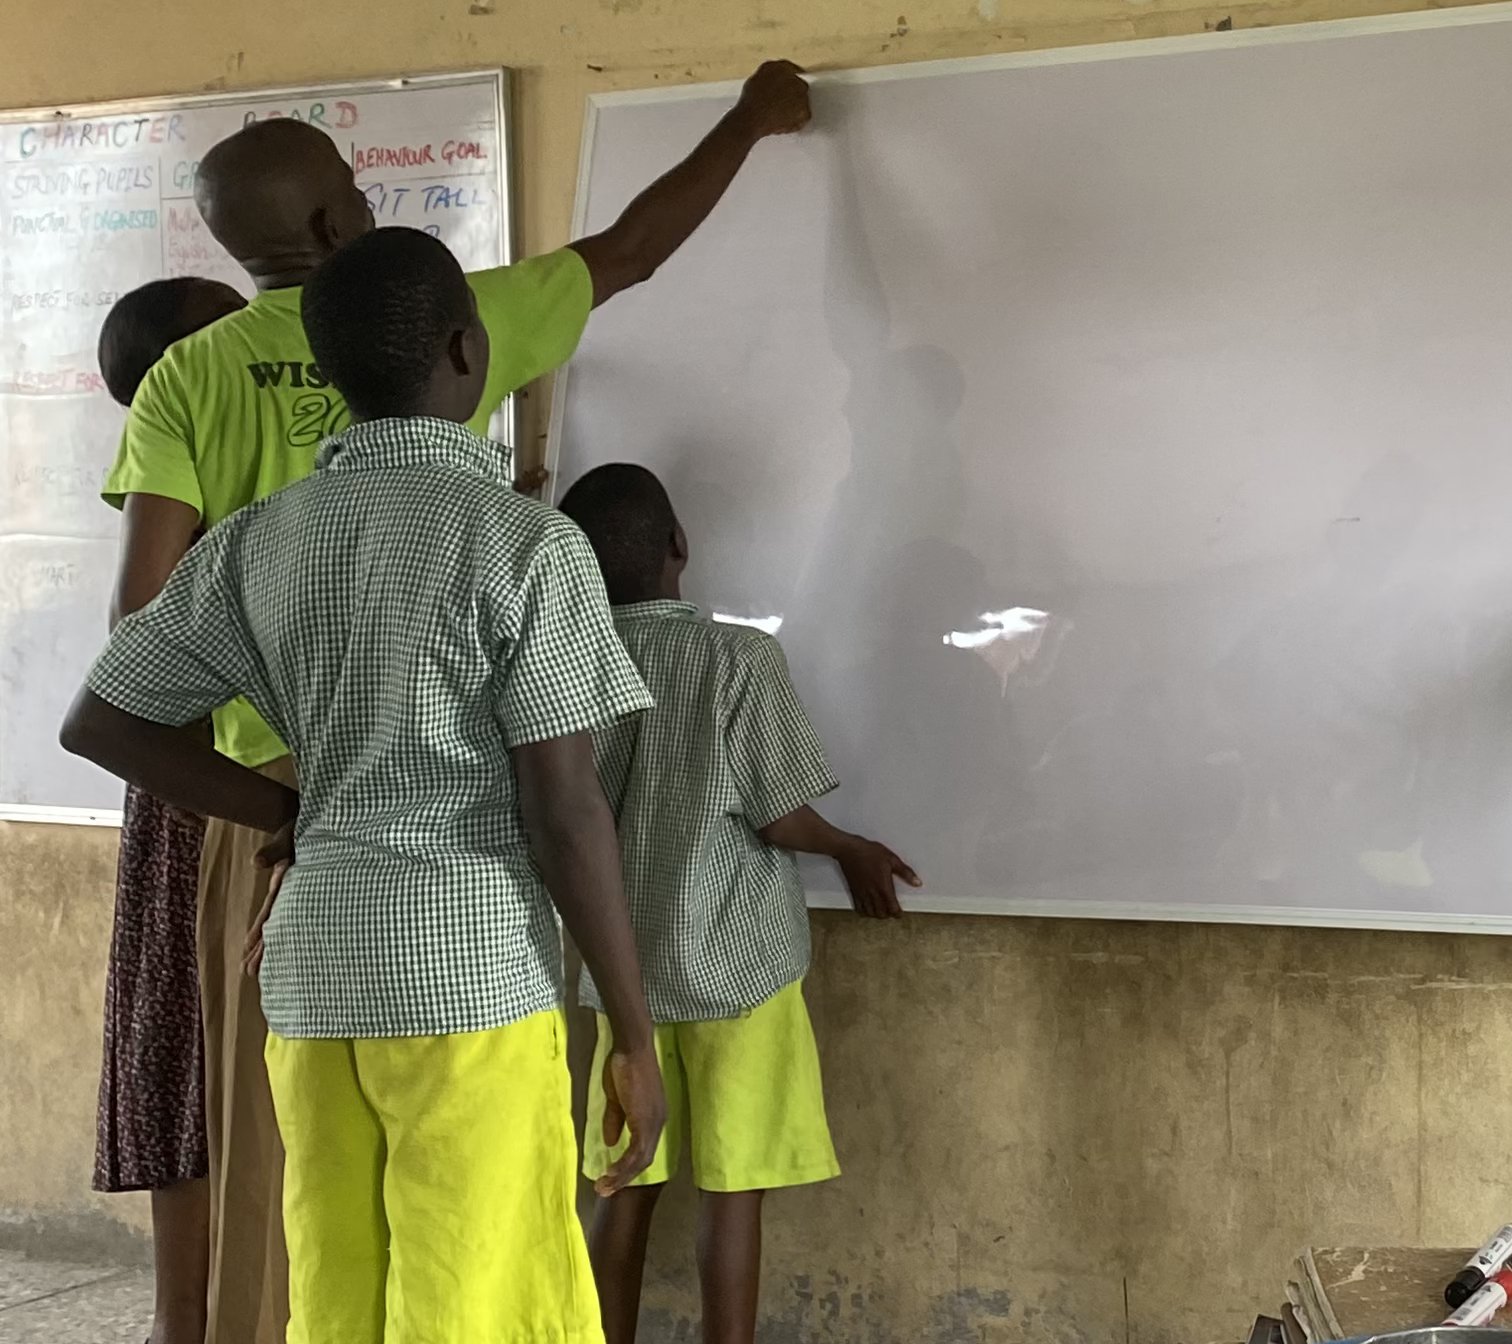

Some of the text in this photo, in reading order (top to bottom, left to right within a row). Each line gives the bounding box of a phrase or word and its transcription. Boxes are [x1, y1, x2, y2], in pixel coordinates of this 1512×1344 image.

[20, 114, 186, 158] CHARACTER
[354, 140, 488, 174] BEHAVIOUR GOAL
[95, 166, 153, 194] PUPILS
[364, 183, 487, 216] SIT TALL
[247, 361, 333, 389] WIS
